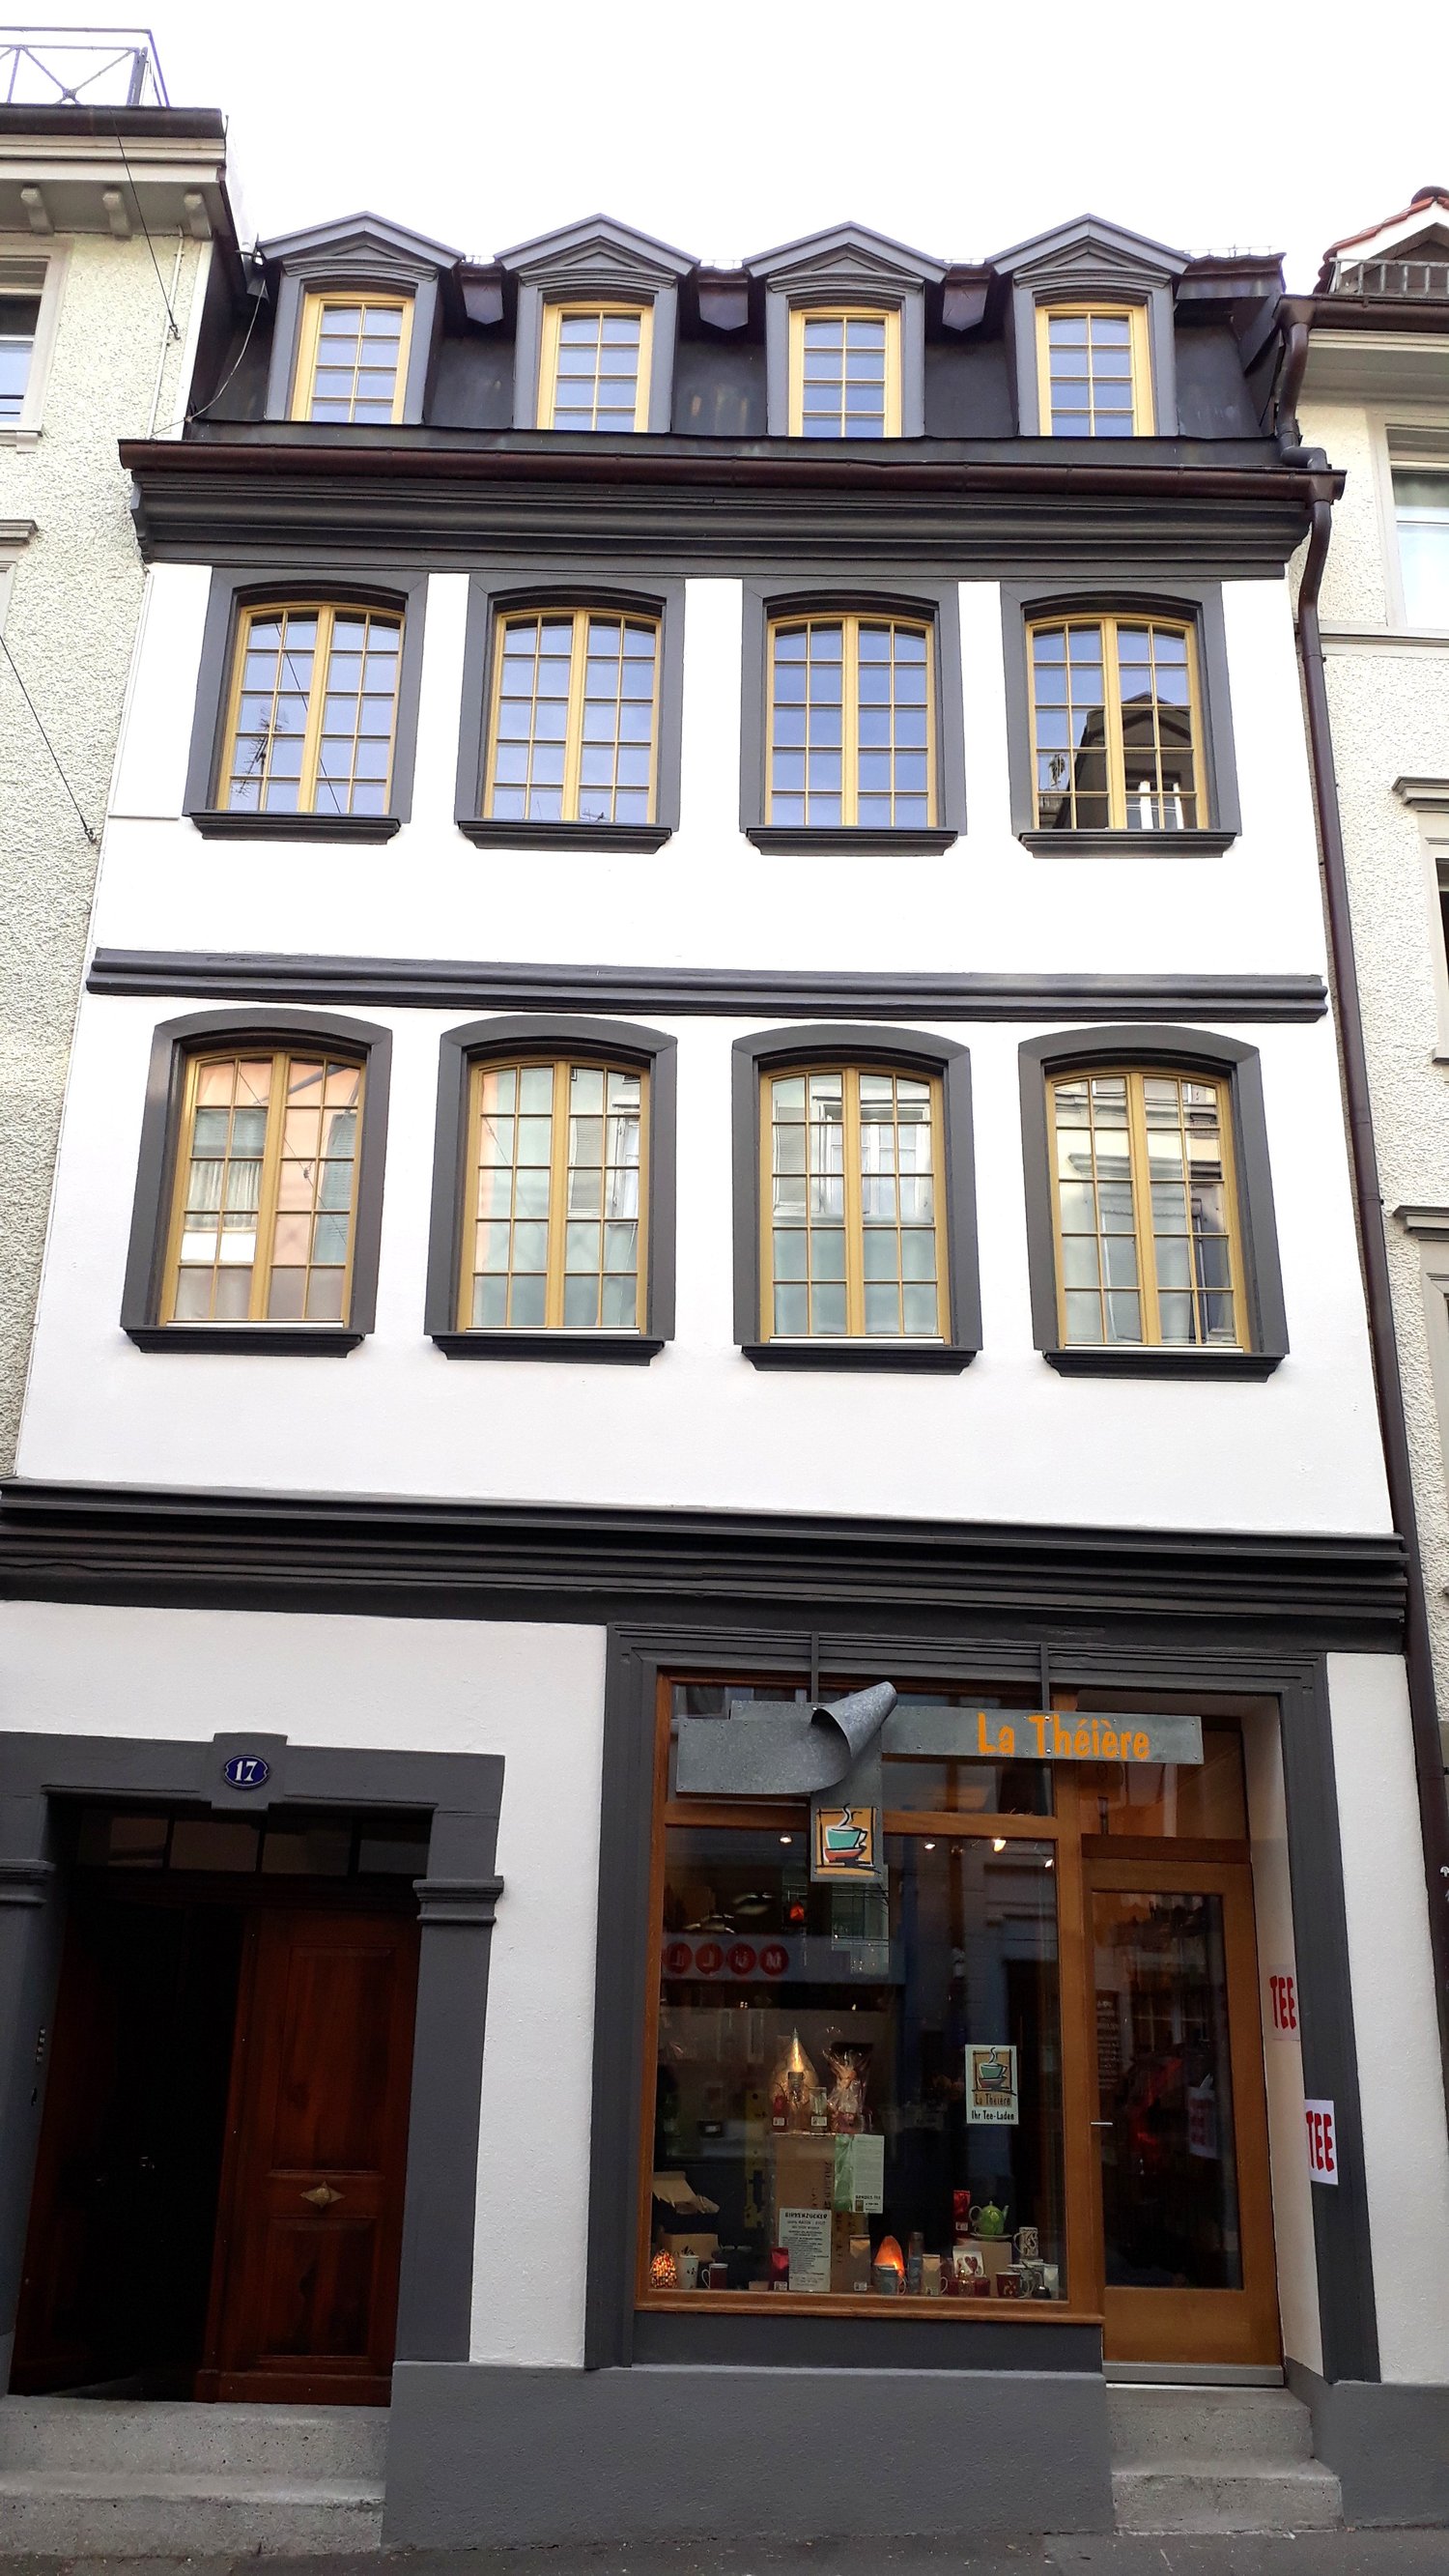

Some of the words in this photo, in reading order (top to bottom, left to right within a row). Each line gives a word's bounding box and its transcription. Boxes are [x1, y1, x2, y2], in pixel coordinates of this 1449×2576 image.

[978, 1711, 1014, 1755] La
[1027, 1713, 1150, 1760] Théière
[235, 1760, 258, 1782] 17
[1269, 1975, 1296, 2029] TEE
[971, 2109, 981, 2120] Ihr
[982, 2109, 1015, 2121] Tee-Laden
[1305, 2110, 1335, 2172] TEE
